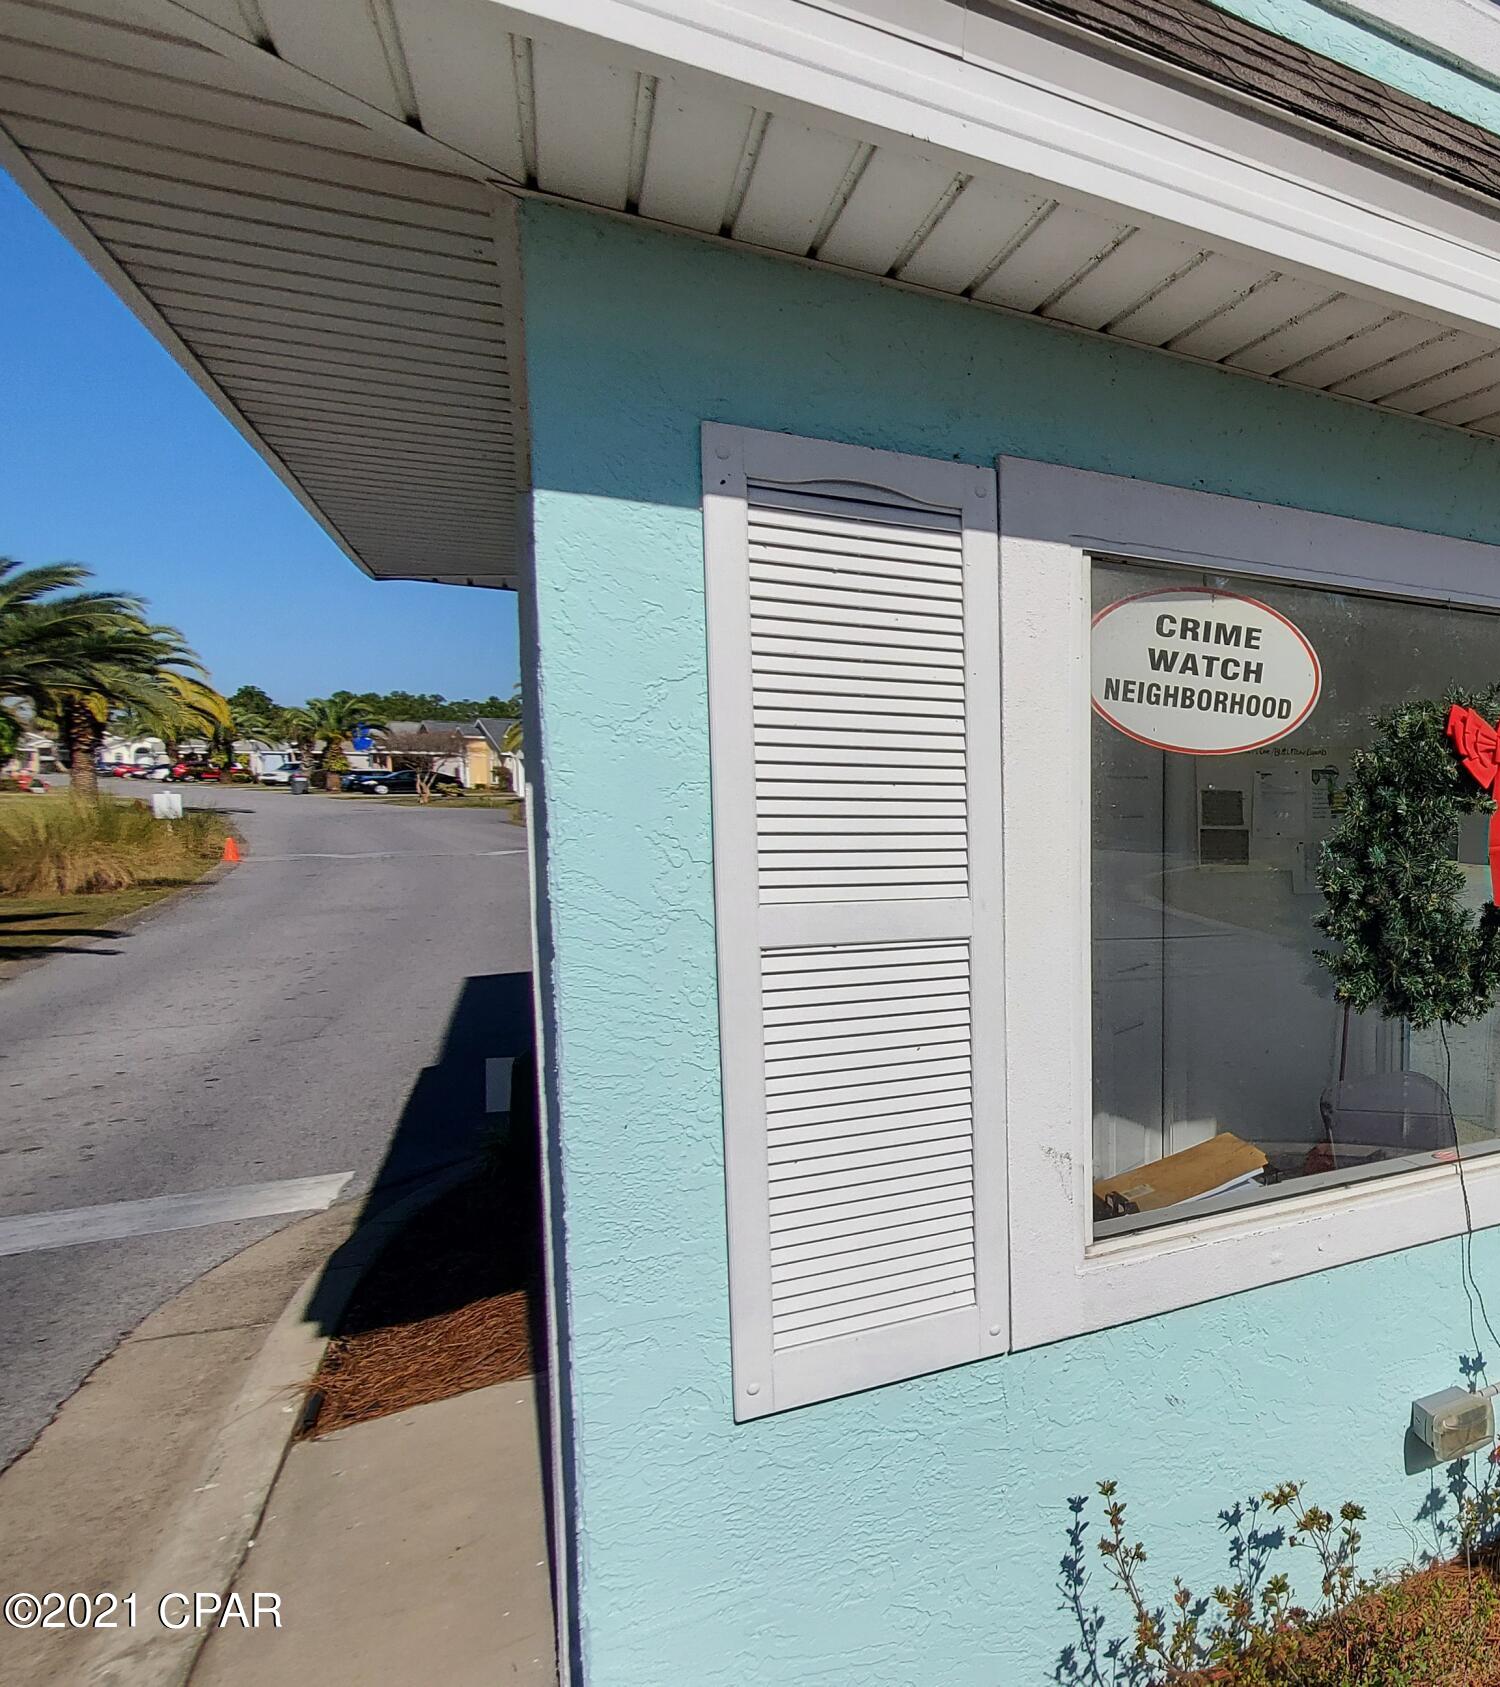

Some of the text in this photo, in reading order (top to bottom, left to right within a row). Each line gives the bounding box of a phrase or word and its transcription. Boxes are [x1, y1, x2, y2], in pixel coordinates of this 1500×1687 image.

[1155, 613, 1262, 650] CRIME
[1148, 647, 1264, 684] WATCH
[1103, 677, 1292, 720] NEIGHBORHOOD
